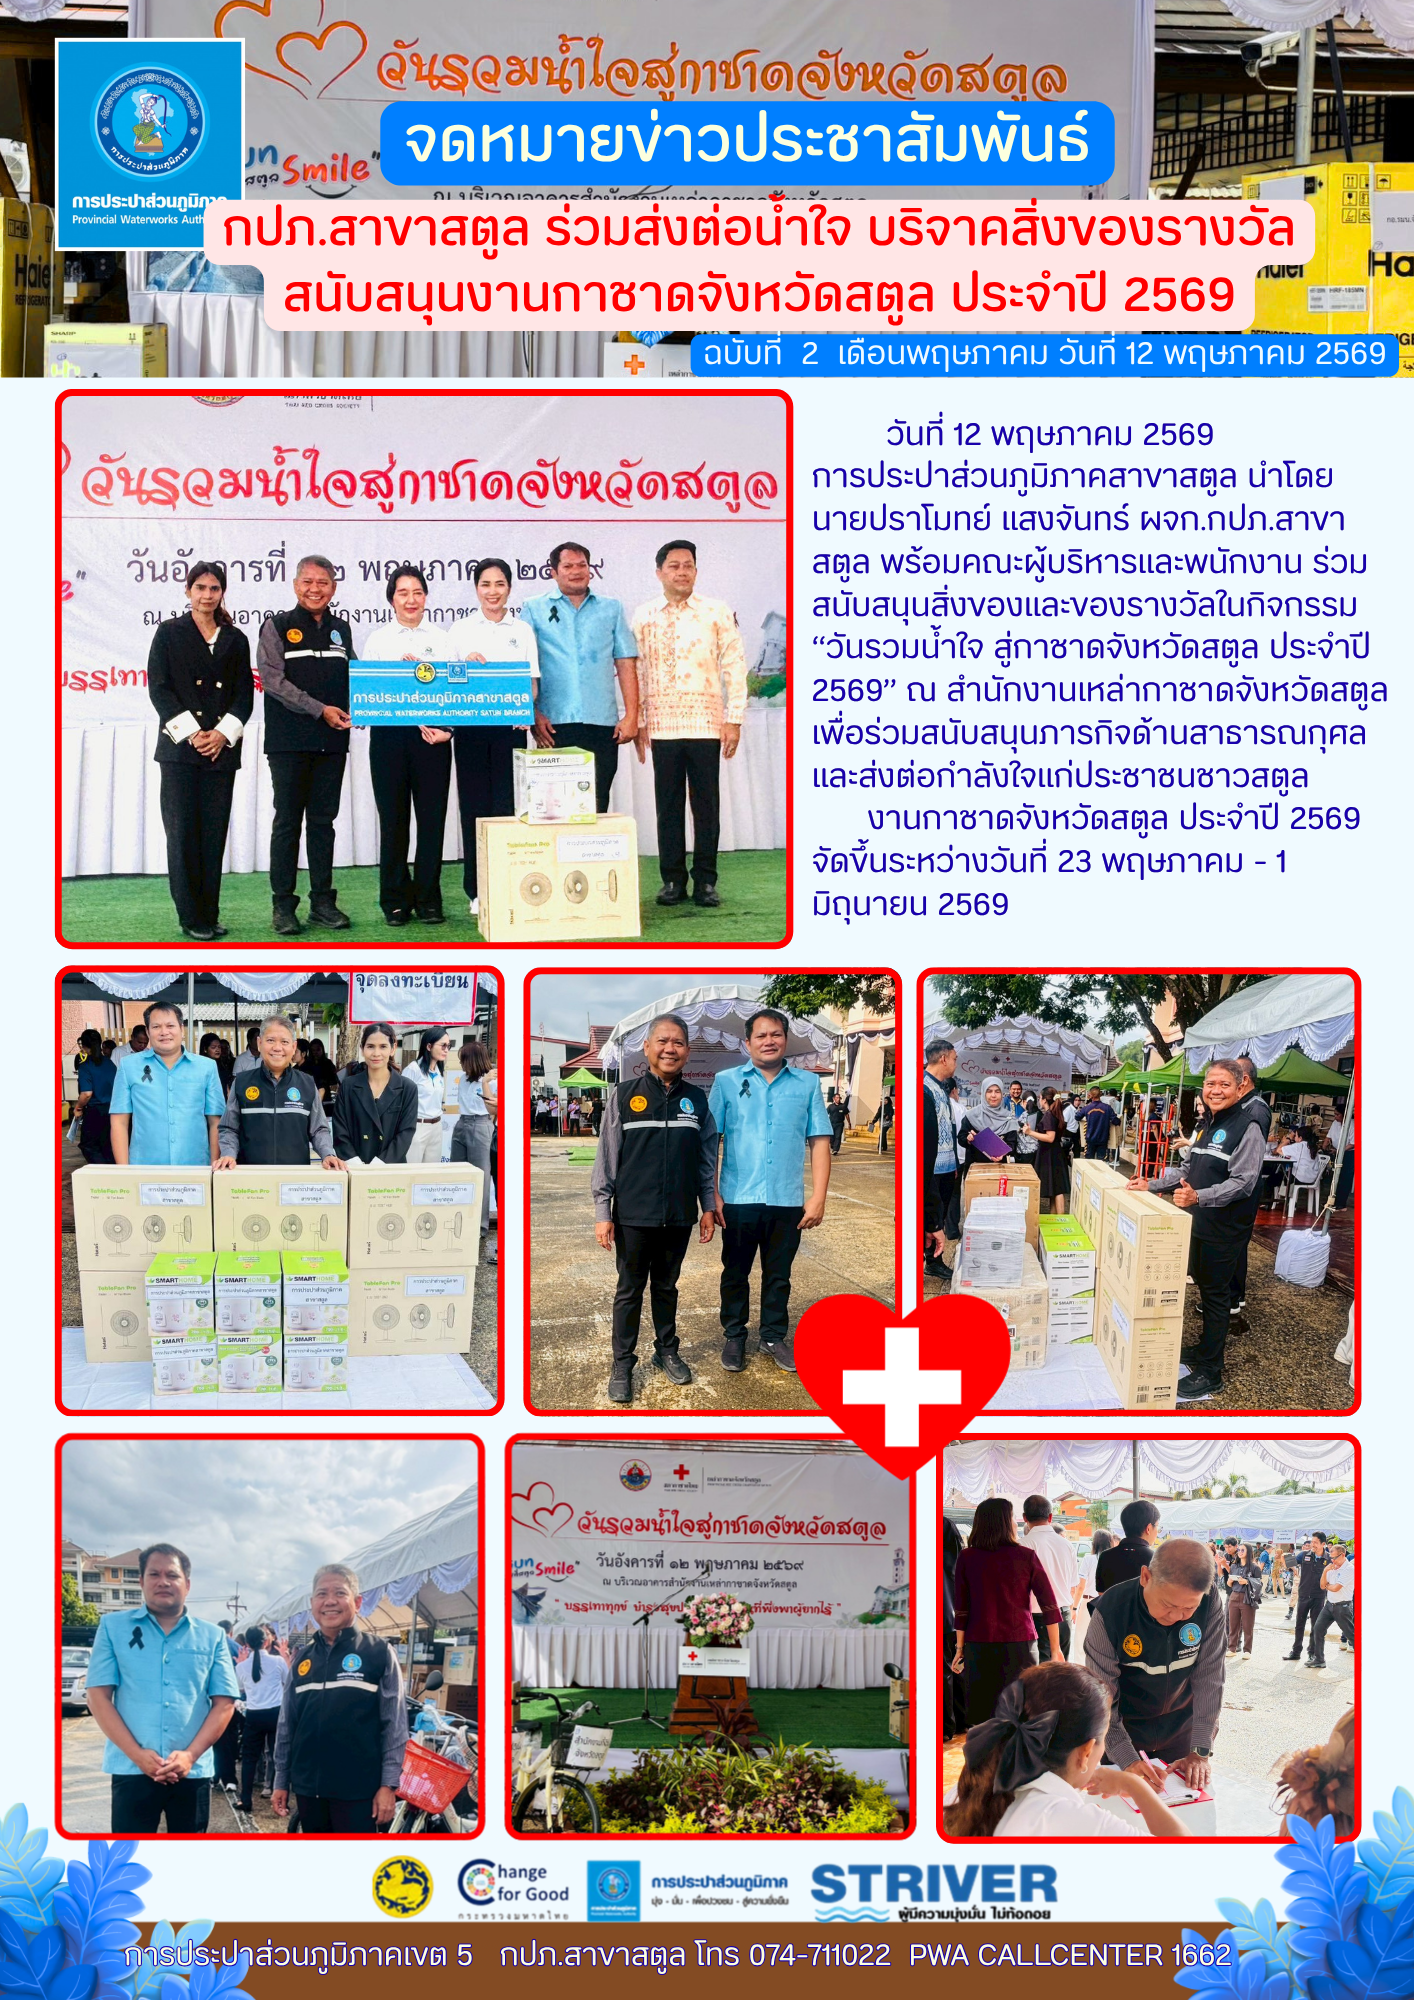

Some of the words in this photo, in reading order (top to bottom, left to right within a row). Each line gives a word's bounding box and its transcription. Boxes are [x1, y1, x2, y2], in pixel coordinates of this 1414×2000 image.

[81, 445, 780, 513] วันรวมน้ำใจสู่กาชาดจังหวัดสตูล
[355, 972, 469, 993] จุดลงทะเบียน
[596, 1550, 664, 1568] วันอังคารที่
